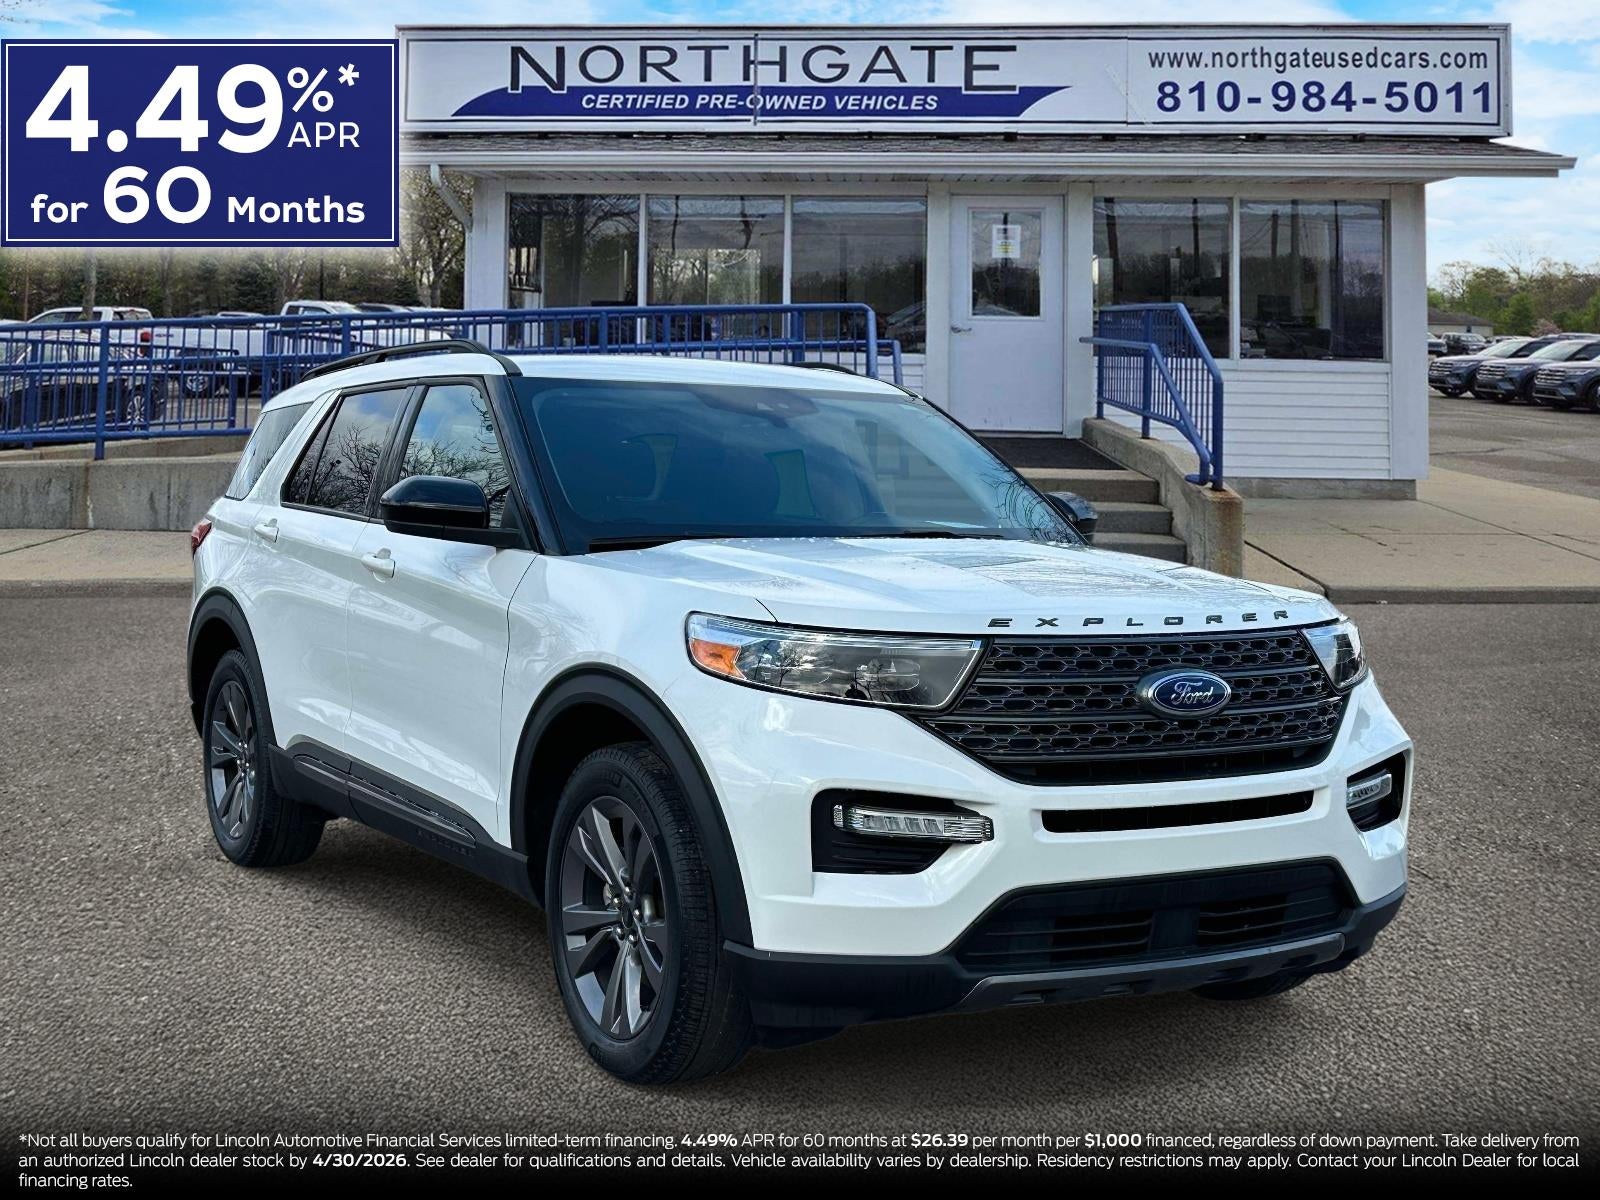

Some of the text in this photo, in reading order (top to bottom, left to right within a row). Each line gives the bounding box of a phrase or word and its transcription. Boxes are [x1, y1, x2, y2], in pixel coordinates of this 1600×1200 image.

[510, 44, 1018, 92] NORTHGATE
[1148, 46, 1488, 74] www.northgateusedcars.com
[581, 93, 939, 111] CERTIFIED PRE-OWNED VEHICLES
[1156, 80, 1491, 114] 810-984-5011
[986, 610, 1290, 629] EXPLORER
[1170, 680, 1215, 707] Ford
